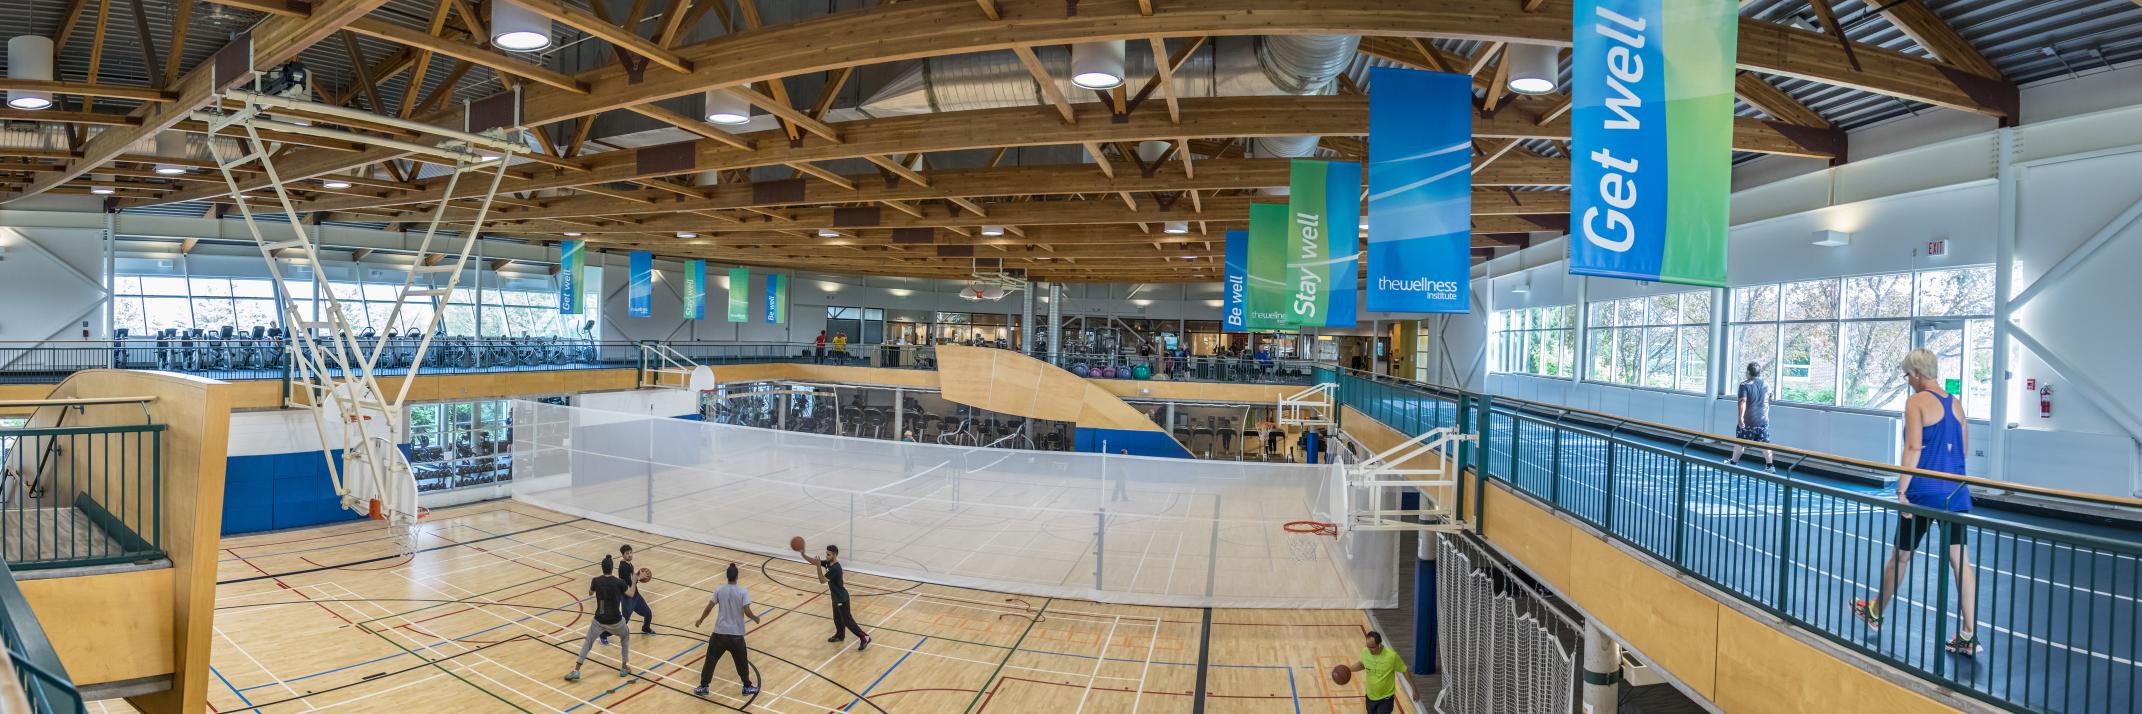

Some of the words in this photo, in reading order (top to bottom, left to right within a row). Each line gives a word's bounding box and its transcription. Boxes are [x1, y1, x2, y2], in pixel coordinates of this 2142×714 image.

[1595, 6, 1647, 130] well
[1582, 148, 1639, 253] Get
[1296, 213, 1319, 259] well
[1928, 241, 1944, 255] EXIT
[563, 269, 571, 291] well
[1230, 275, 1243, 304] well
[1293, 266, 1322, 318] Stay
[1378, 275, 1458, 293] thewellness
[562, 293, 571, 311] Get
[1228, 307, 1242, 327] Be
